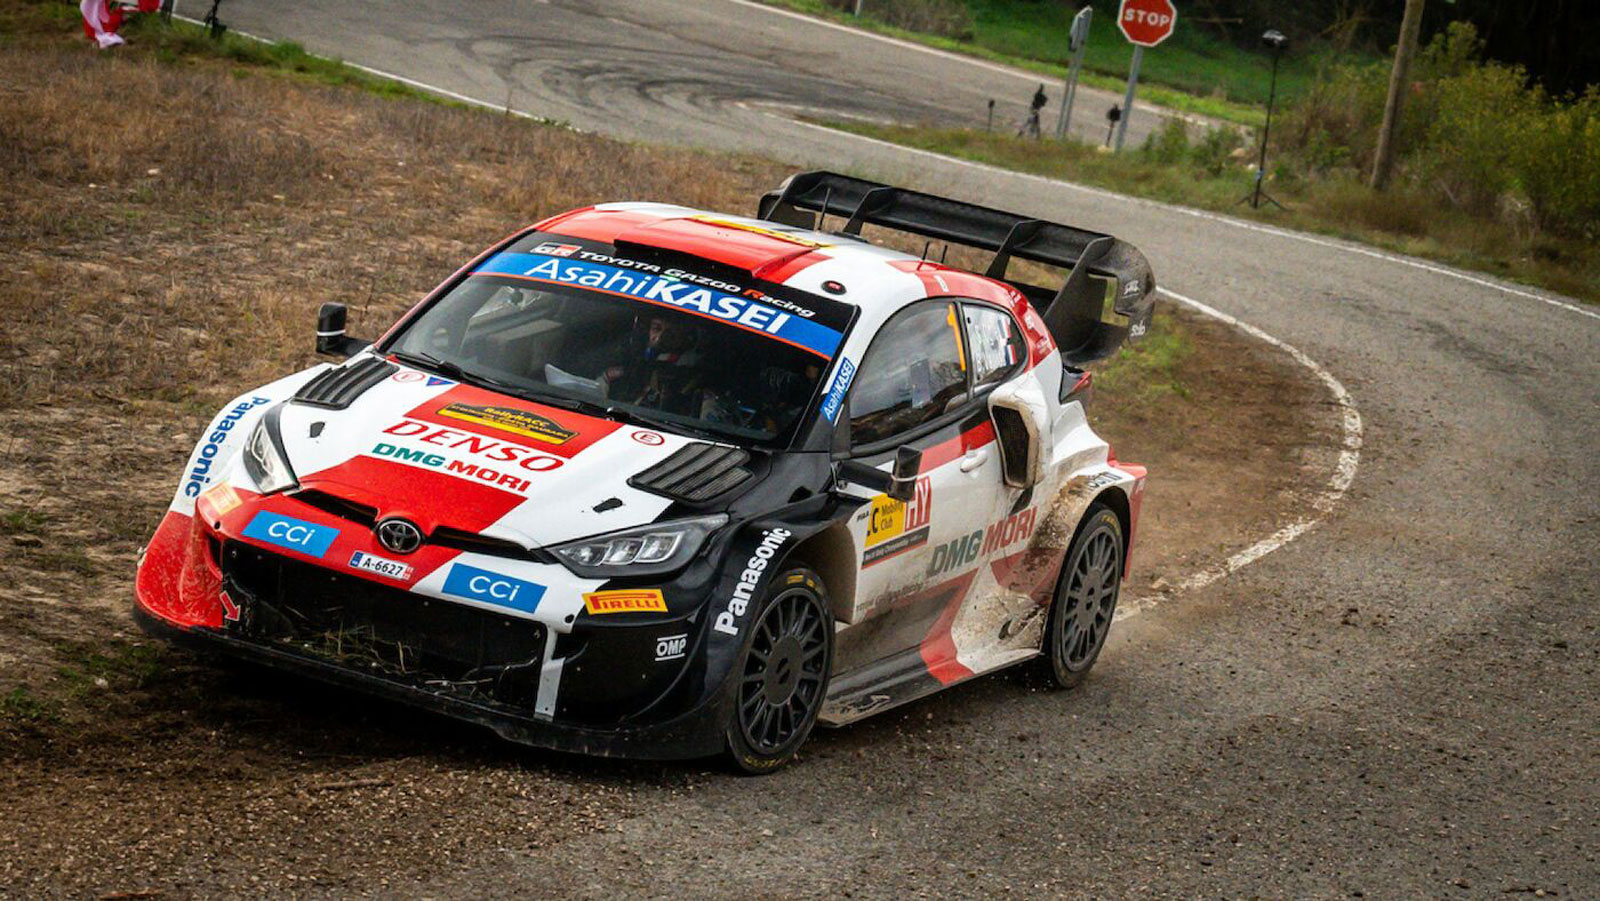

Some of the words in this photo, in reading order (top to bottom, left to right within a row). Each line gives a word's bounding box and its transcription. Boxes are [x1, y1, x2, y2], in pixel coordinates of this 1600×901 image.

[1124, 8, 1170, 27] STOP
[524, 258, 791, 334] AsahiKASEI
[580, 251, 661, 272] TOYOTA
[664, 268, 742, 292] GAZOO
[743, 289, 816, 318] Racing
[185, 396, 271, 498] Panasonic
[371, 443, 446, 467] DMG
[447, 460, 531, 492] MORI
[382, 420, 564, 471] DENSO
[926, 530, 984, 578] DMG
[982, 505, 1038, 557] MORI
[362, 558, 404, 578] A-6627
[713, 528, 792, 636] Panasonic
[589, 593, 660, 610] PIRELLI
[656, 638, 687, 657] OMP
